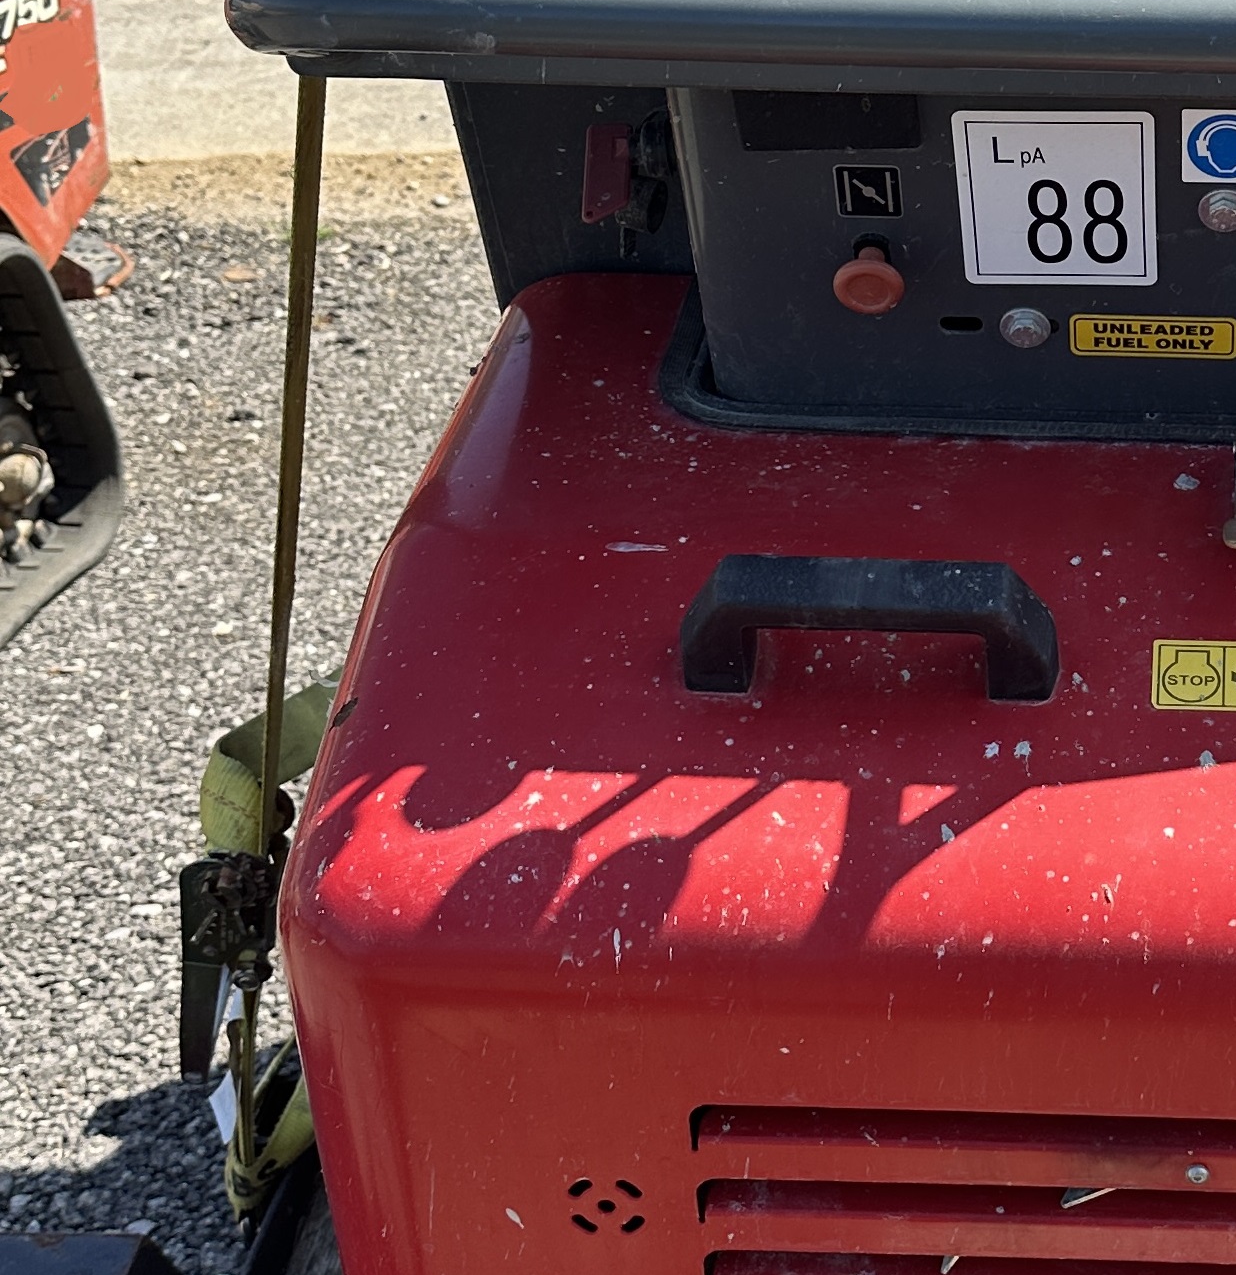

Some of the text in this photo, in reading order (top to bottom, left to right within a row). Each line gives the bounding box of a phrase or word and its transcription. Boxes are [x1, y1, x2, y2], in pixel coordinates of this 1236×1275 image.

[1027, 179, 1128, 264] 88
[1093, 322, 1214, 336] UNLEADED
[1093, 337, 1214, 350] FUEL ONLY
[1167, 674, 1215, 686] STOP
